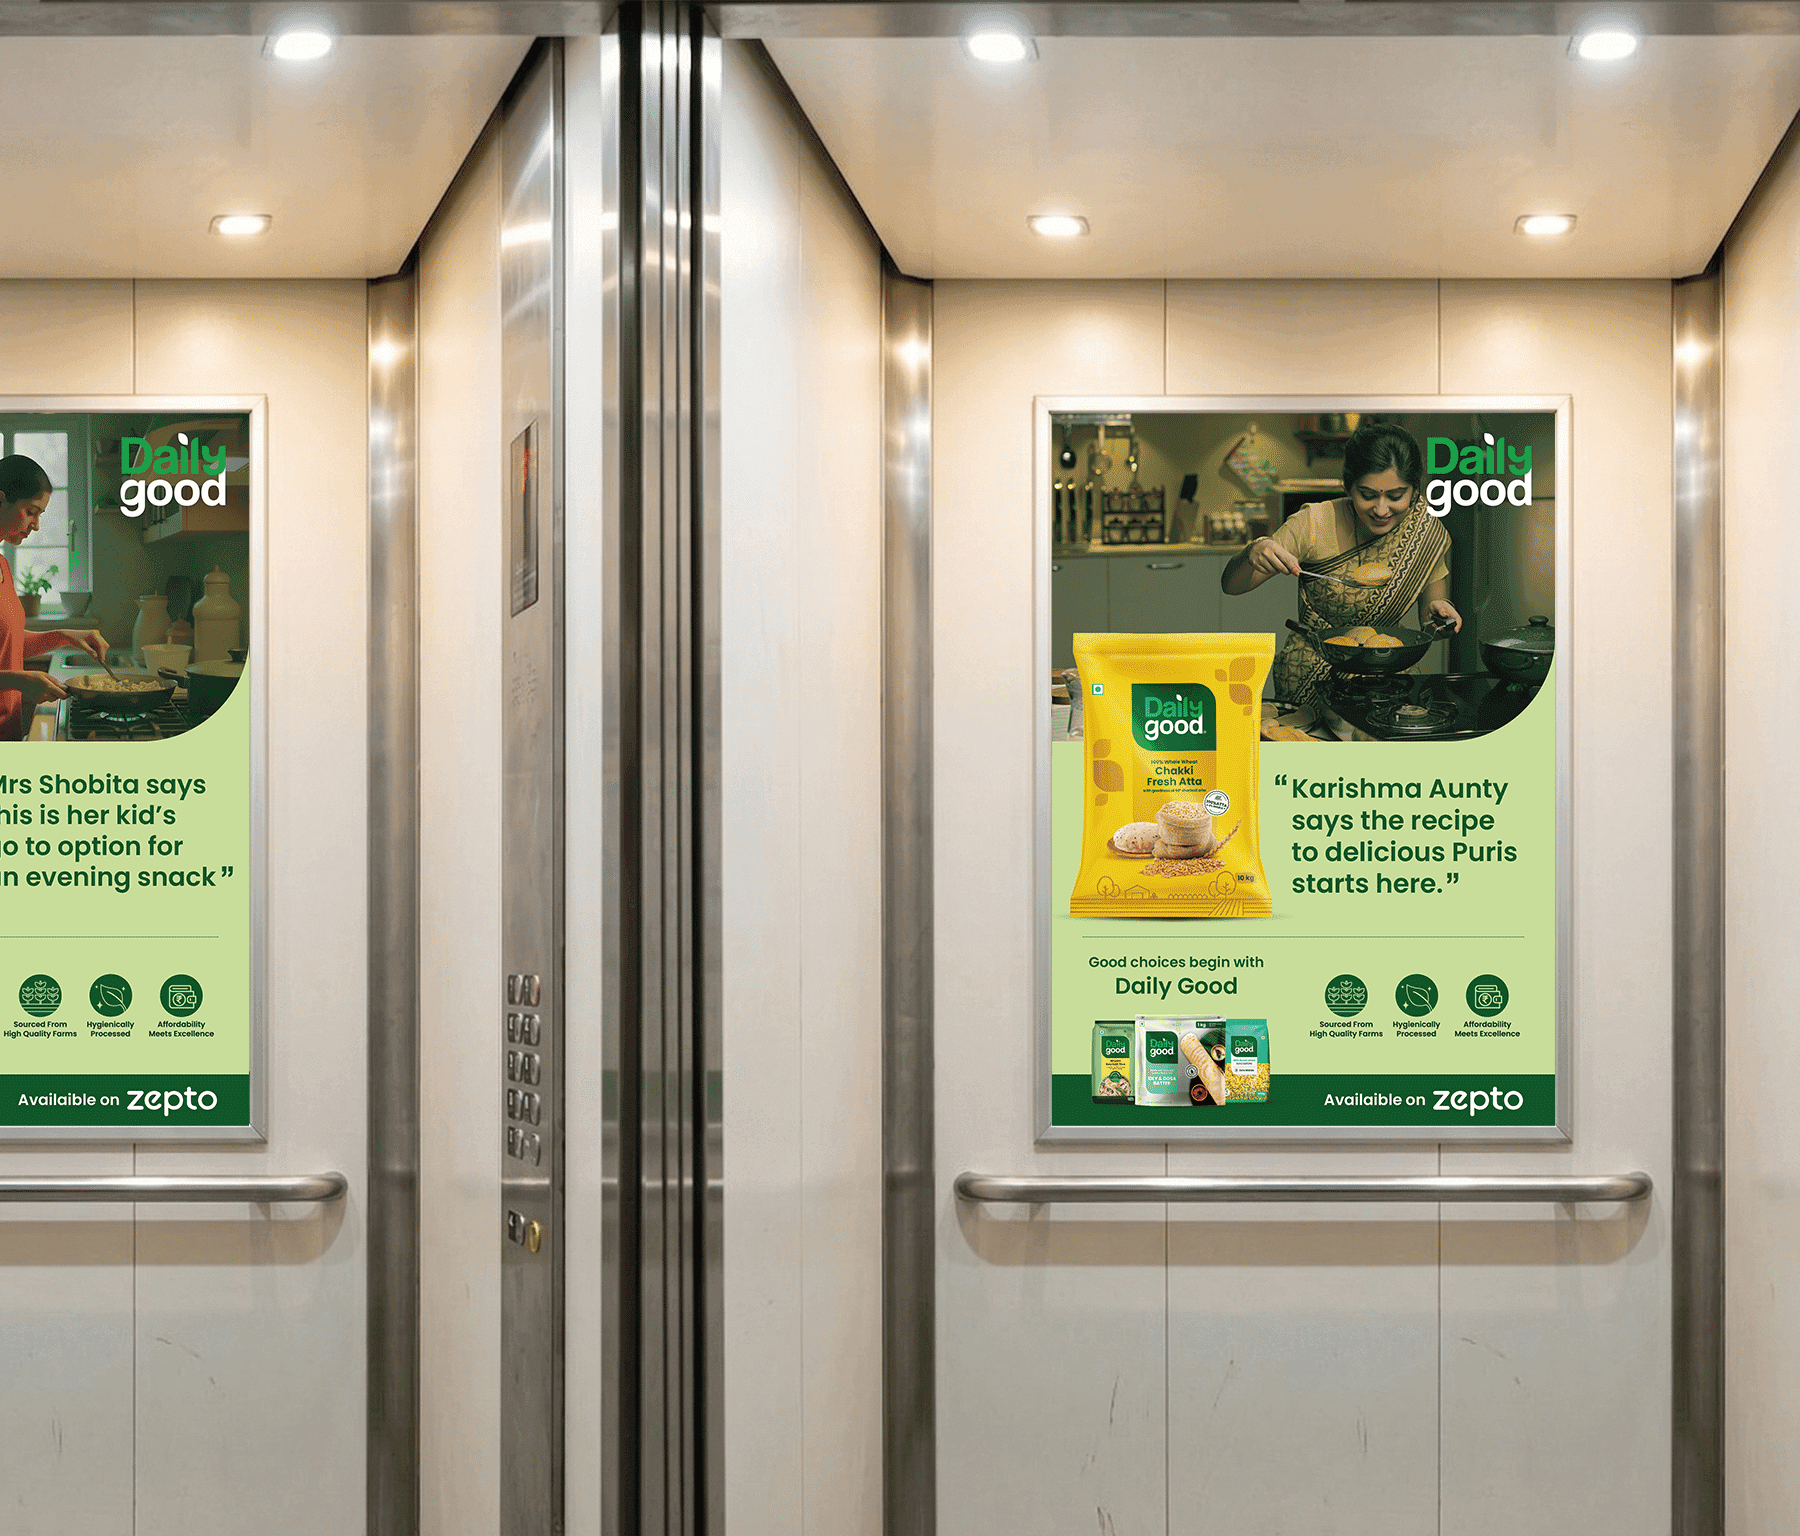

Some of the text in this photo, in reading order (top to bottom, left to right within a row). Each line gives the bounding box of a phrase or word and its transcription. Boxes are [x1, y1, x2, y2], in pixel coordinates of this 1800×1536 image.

[121, 433, 226, 477] Daily
[1427, 433, 1532, 477] Daily
[120, 468, 226, 518] good
[1426, 468, 1532, 518] good
[1144, 694, 1203, 718] Daily
[1144, 714, 1203, 741] good
[1155, 766, 1194, 775] Chakki
[39, 772, 139, 795] Shobita
[146, 778, 206, 801] says
[1147, 777, 1202, 786] Fresh Atta
[1429, 778, 1509, 806] Aunty
[40, 803, 60, 825] is
[67, 803, 110, 825] her
[117, 803, 176, 825] kid’s
[1293, 808, 1495, 838] says the recipe
[26, 836, 51, 856] to
[58, 834, 141, 861] option
[148, 834, 184, 856] for
[1292, 839, 1518, 862] to delicious Puris
[26, 865, 130, 894] evening
[1293, 873, 1369, 894] starts
[1089, 955, 1264, 972] Good choices begin with
[1115, 976, 1238, 1001] Daily Good
[13, 1020, 68, 1029] Sourced From
[86, 1020, 135, 1030] Hygienically
[157, 1020, 206, 1030] Affordability
[1319, 1020, 1374, 1029] Sourced From
[1392, 1020, 1441, 1030] Hygienically
[1463, 1020, 1512, 1030] Affordability
[3, 1030, 78, 1040] High Quality Farms
[90, 1030, 131, 1038] Processed
[148, 1030, 215, 1038] Meets Excellence
[1309, 1030, 1384, 1040] High Quality Farms
[1396, 1030, 1437, 1038] Processed
[1454, 1030, 1521, 1038] Meets Excellence
[1106, 1047, 1126, 1055] good
[1150, 1038, 1174, 1048] Daily
[1150, 1047, 1174, 1058] good
[99, 1095, 120, 1106] on
[126, 1086, 218, 1117] zepto
[1405, 1095, 1426, 1106] on
[1432, 1086, 1524, 1117] zepto
